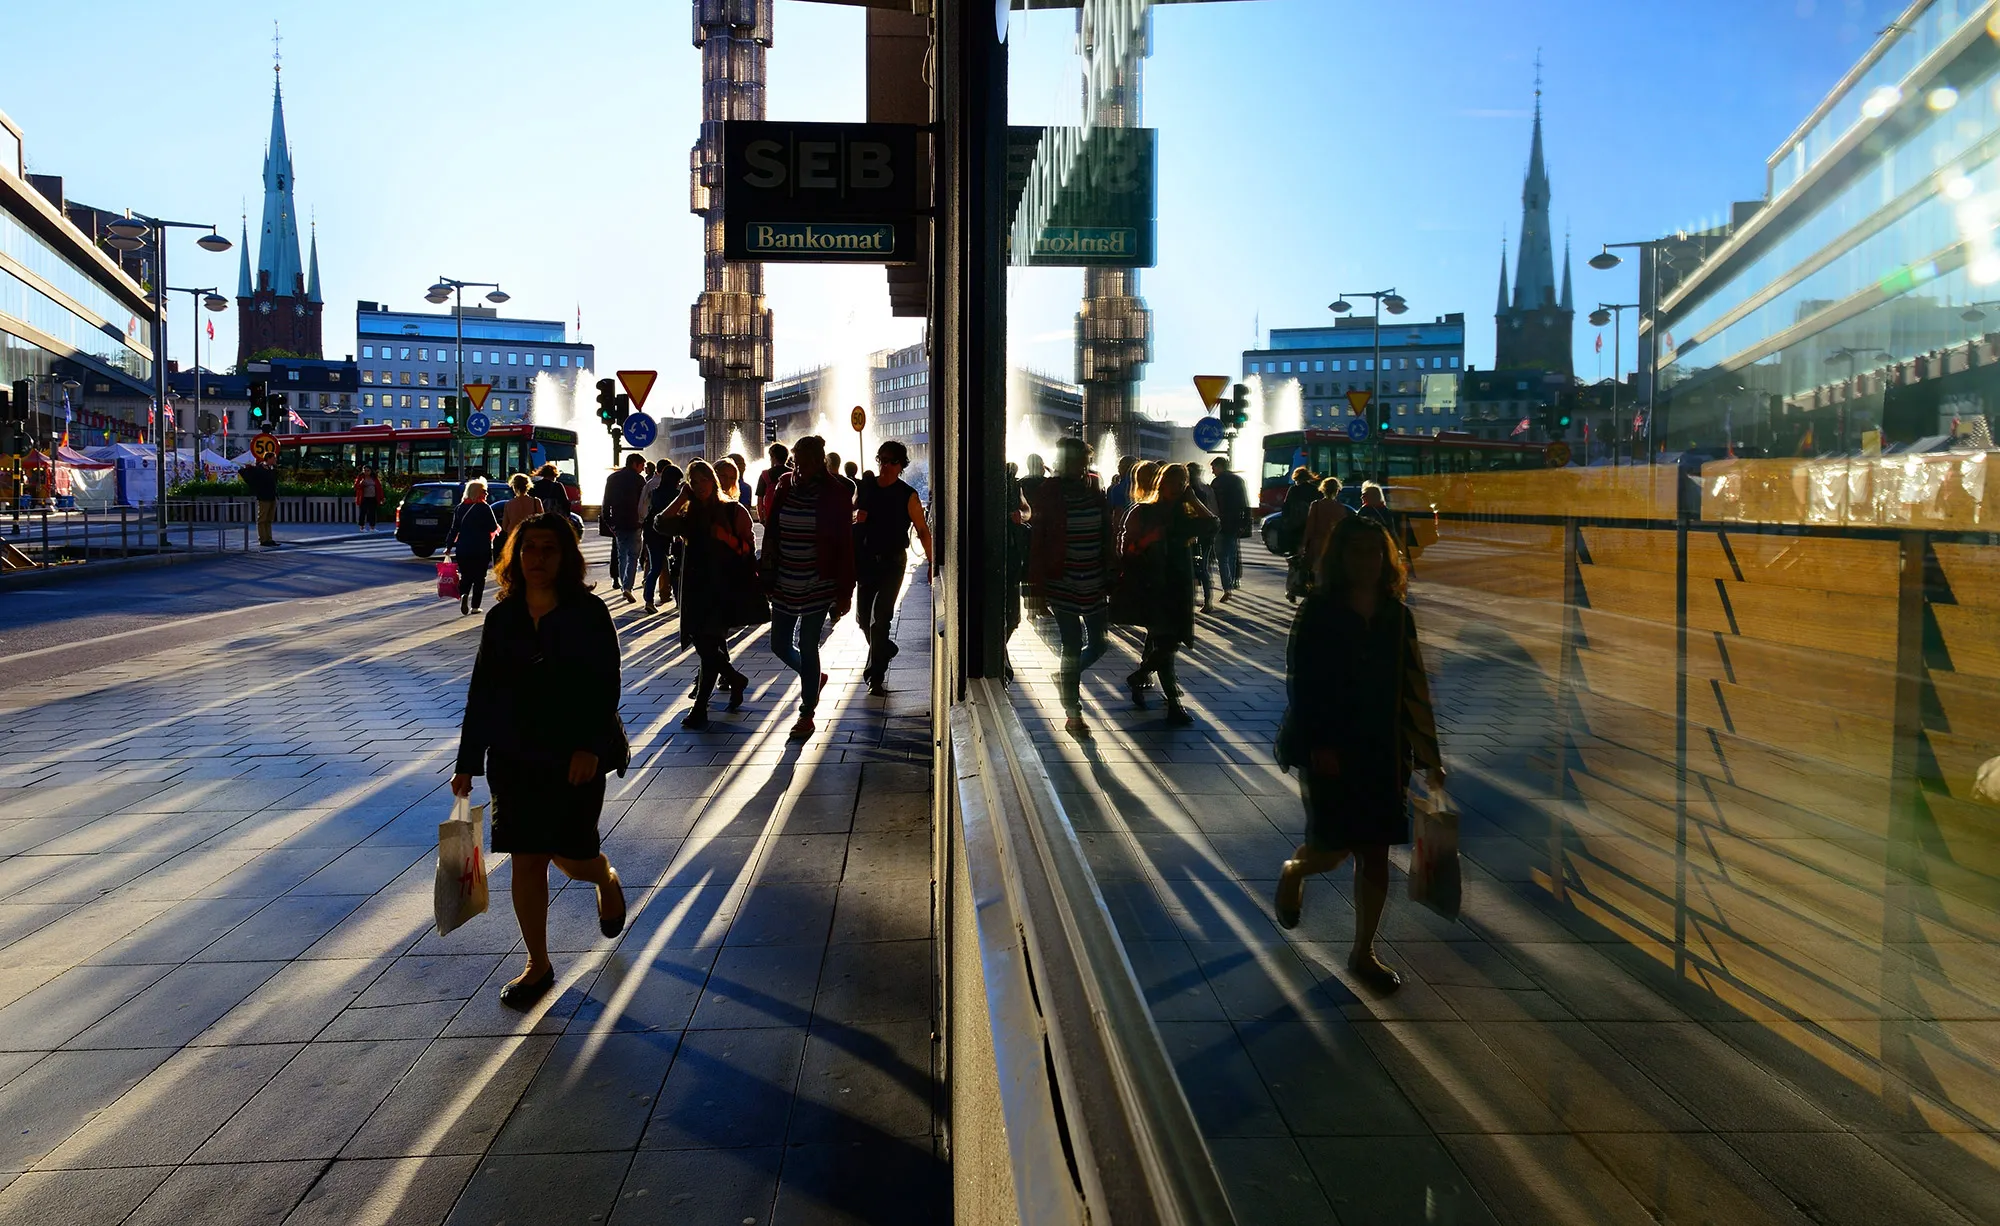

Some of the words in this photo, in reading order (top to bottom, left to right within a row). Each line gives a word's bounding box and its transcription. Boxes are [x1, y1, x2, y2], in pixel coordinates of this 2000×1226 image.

[742, 138, 896, 189] SEB
[756, 225, 884, 250] Bankomat
[854, 412, 864, 425] 50
[256, 440, 275, 454] 50
